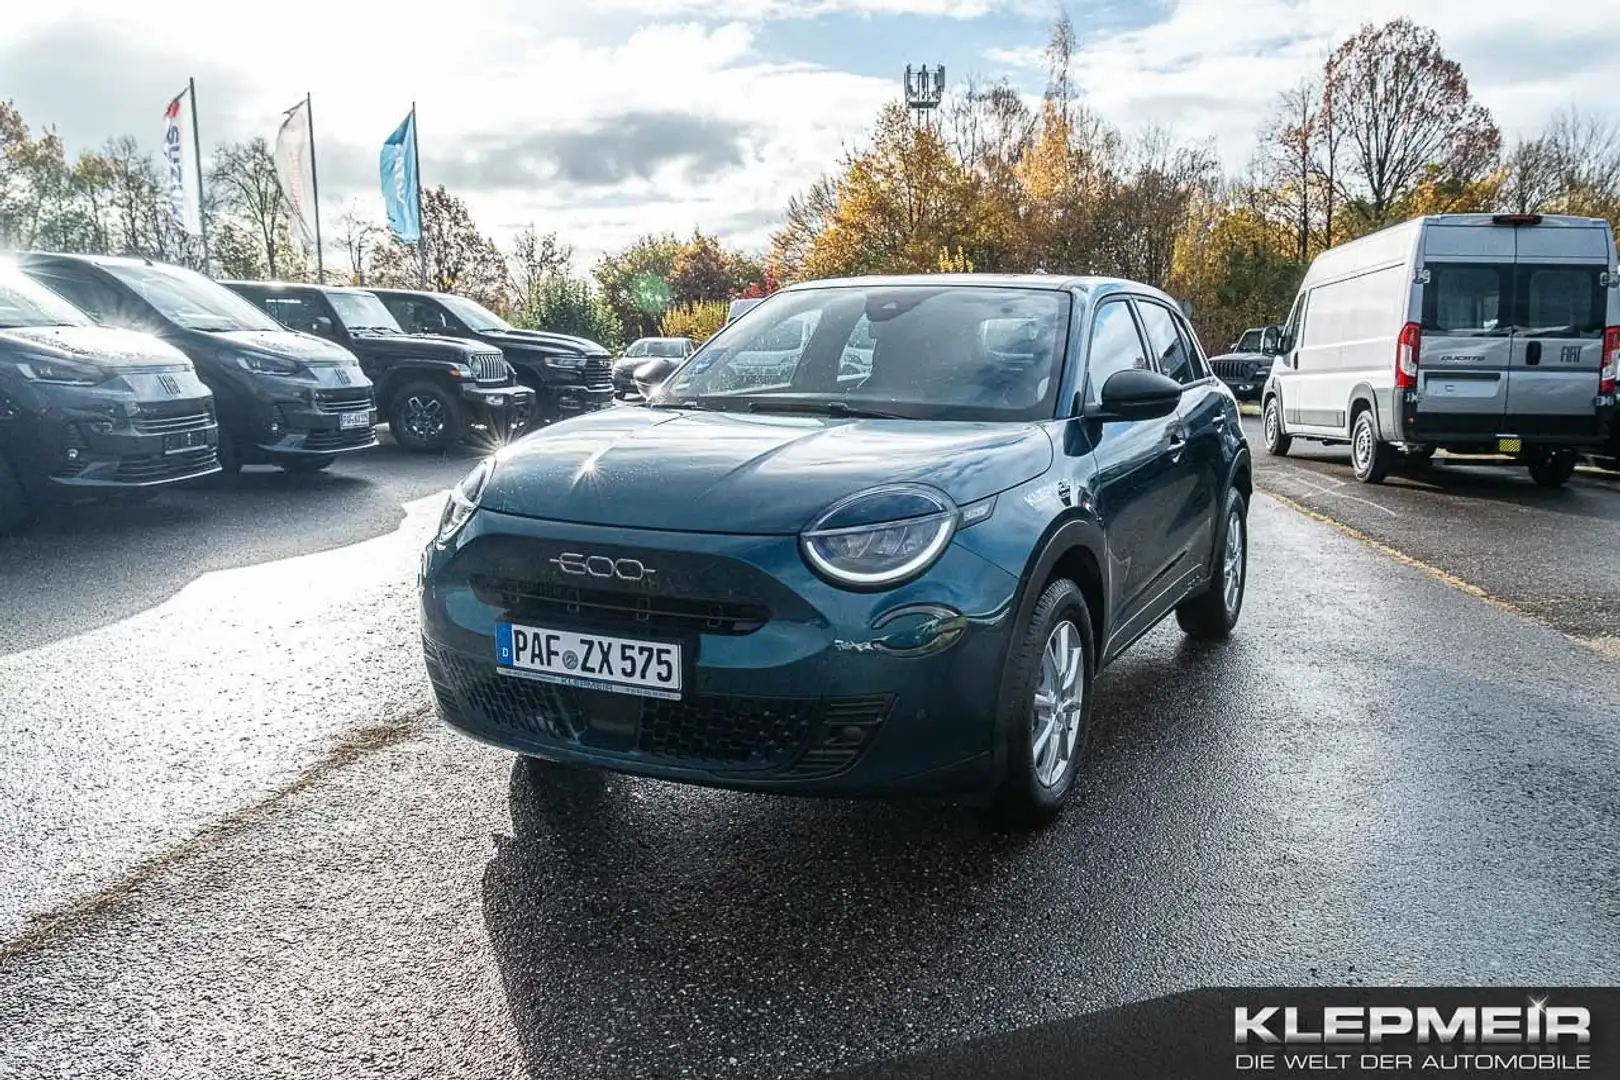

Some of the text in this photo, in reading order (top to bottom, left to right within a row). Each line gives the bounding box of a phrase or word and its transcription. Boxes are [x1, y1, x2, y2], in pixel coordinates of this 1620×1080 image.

[165, 124, 184, 228] SUZU
[1560, 346, 1582, 363] FIAT
[514, 629, 673, 682] PAF ZX 575
